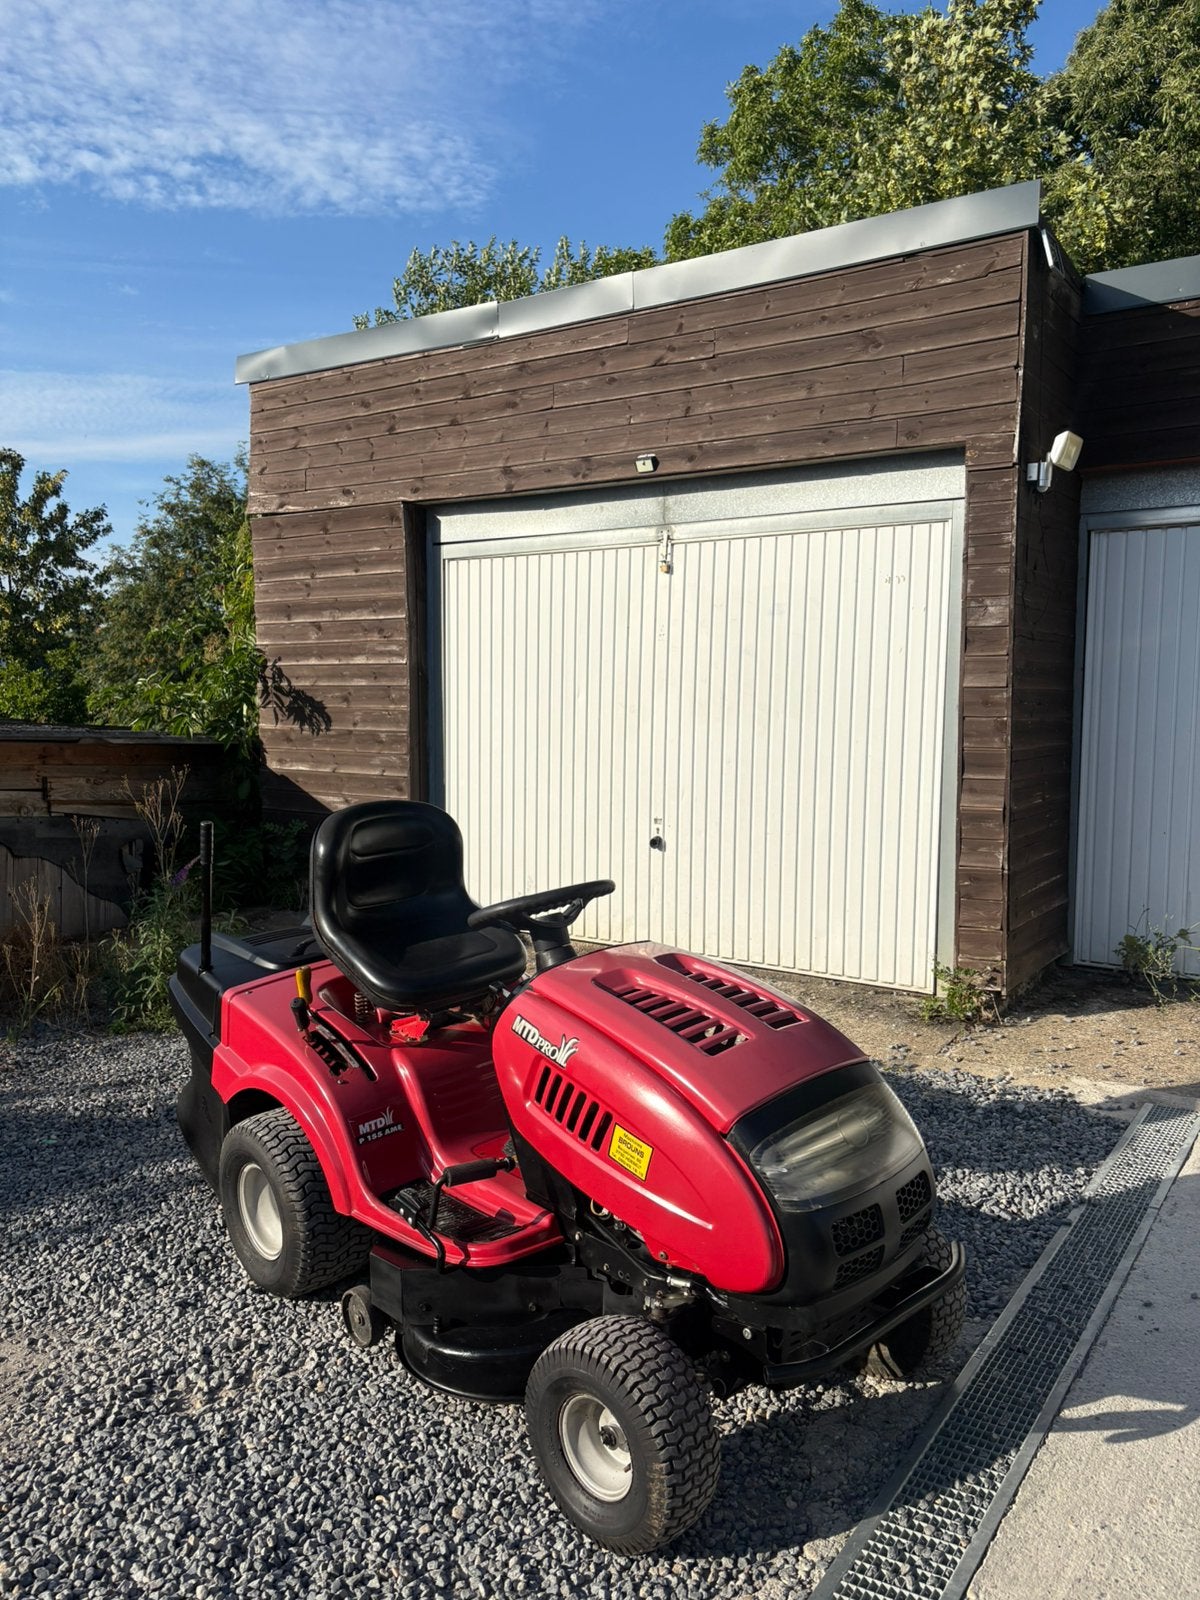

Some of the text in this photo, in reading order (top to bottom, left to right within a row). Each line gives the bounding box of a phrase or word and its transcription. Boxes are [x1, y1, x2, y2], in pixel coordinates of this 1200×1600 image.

[358, 1117, 386, 1135] MTD
[384, 1124, 402, 1135] AME
[618, 1136, 645, 1158] BROUNS
